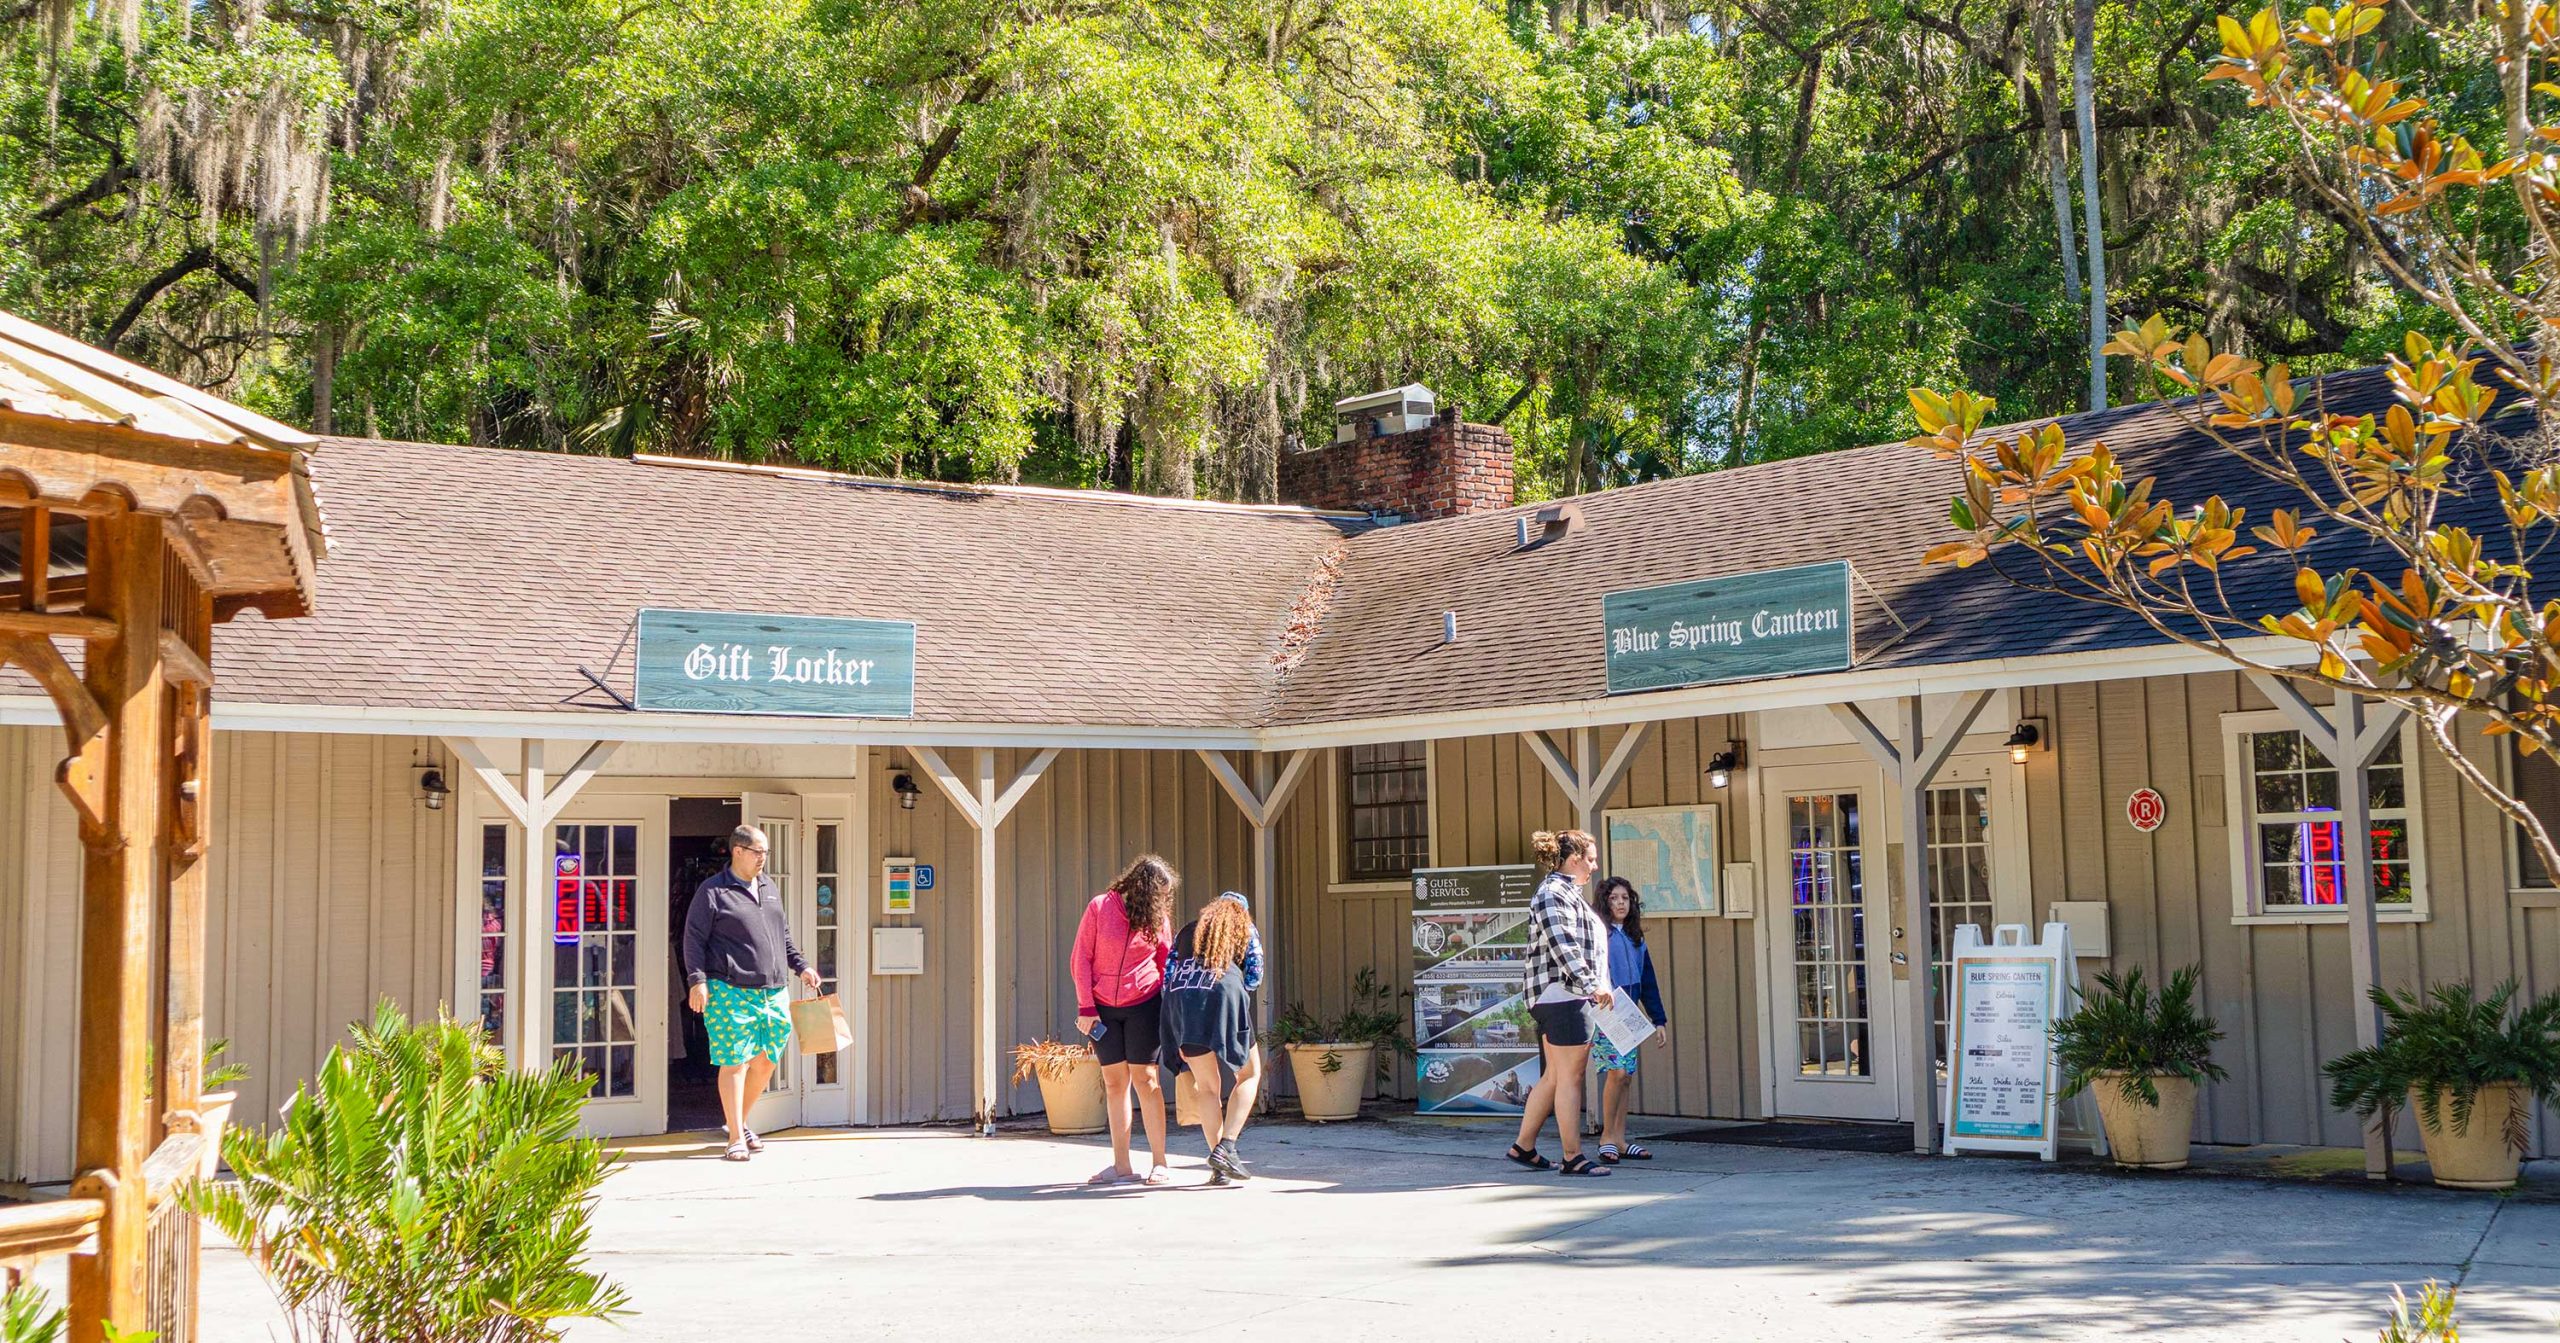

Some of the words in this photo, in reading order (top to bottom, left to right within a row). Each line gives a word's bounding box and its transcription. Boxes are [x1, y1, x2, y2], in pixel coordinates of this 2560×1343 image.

[1612, 627, 1660, 659] Blue
[1669, 615, 1743, 650] Spring
[1751, 608, 1839, 638] Canteen
[684, 643, 753, 681] Gift
[767, 646, 875, 686] Locker
[2141, 802, 2151, 818] R
[1430, 878, 1458, 888] GUEST
[1430, 887, 1470, 898] SERVICES
[1971, 973, 1985, 981] BLUE
[1987, 973, 2011, 981] SPRING
[2013, 972, 2041, 981] CANTEEN
[1969, 1076, 1983, 1085] Kids
[1993, 1076, 2011, 1085] Drinks
[2015, 1077, 2023, 1086] Ice
[2024, 1078, 2041, 1086] Cream
